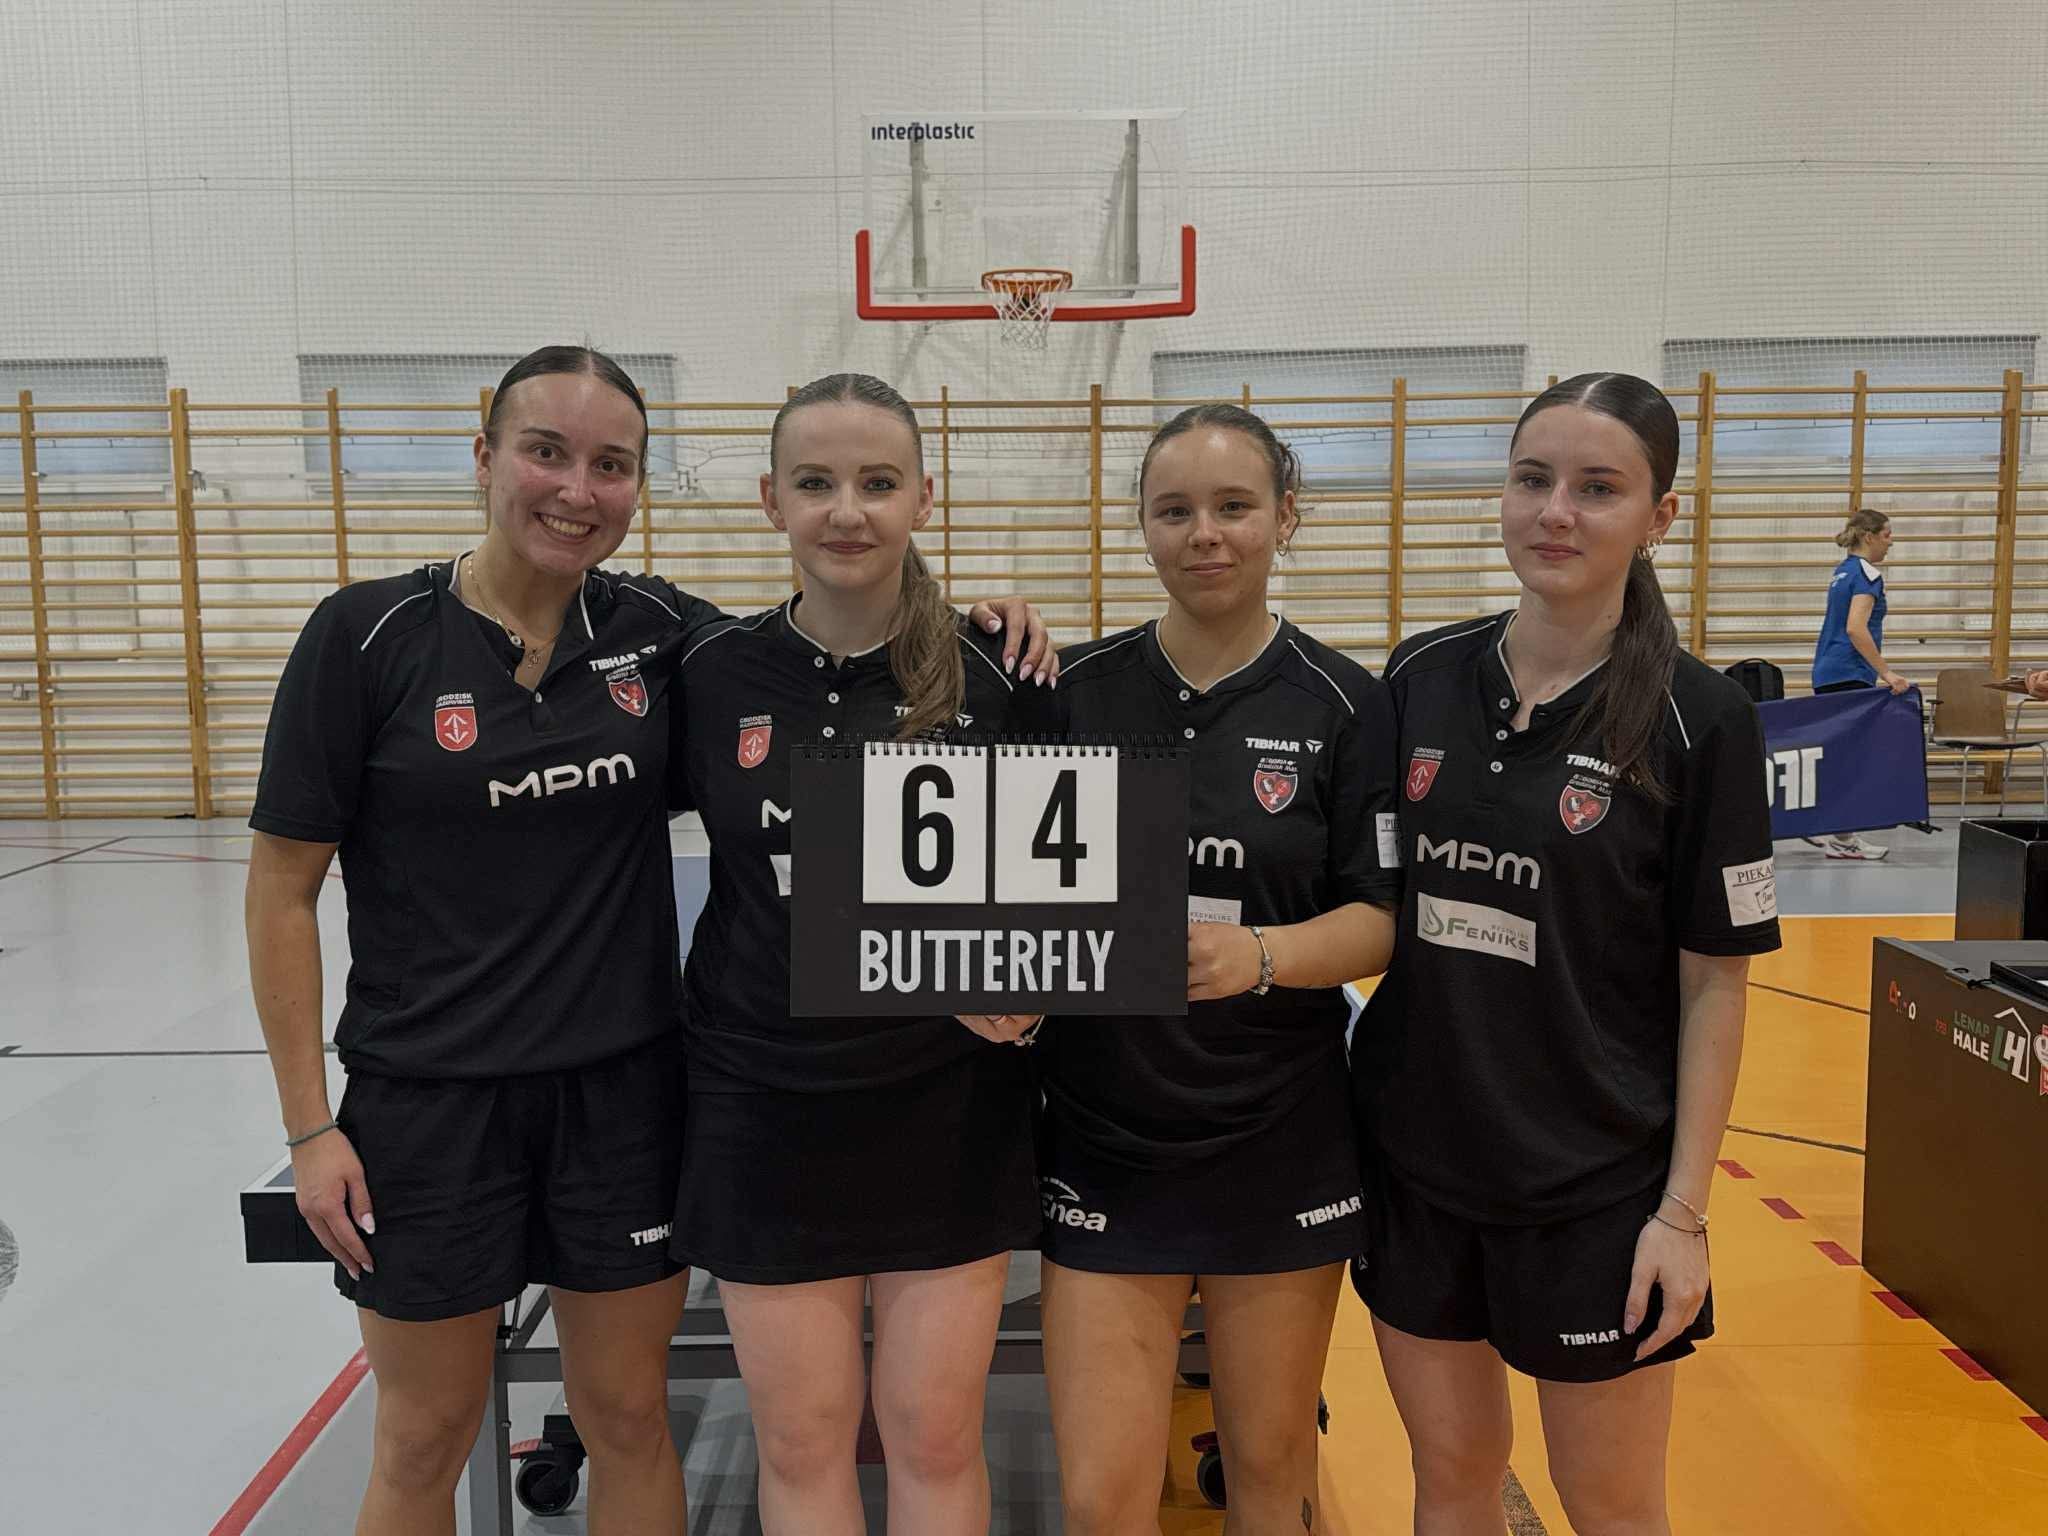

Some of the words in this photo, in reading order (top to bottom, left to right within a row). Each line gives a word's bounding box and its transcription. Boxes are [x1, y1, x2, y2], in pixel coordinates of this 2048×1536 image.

[872, 122, 975, 143] interplastic
[588, 652, 641, 672] TIBHAR
[1244, 737, 1300, 753] TIBHAR
[901, 763, 955, 888] 6
[1031, 769, 1087, 888] 4
[1446, 917, 1529, 953] FENIKS
[859, 929, 1114, 993] BUTTERFLY
[1953, 1010, 1990, 1037] LENAP
[1952, 1027, 1990, 1062] HALE
[1295, 1195, 1362, 1229] TIBHAR
[1559, 1329, 1620, 1346] TIBHAR
